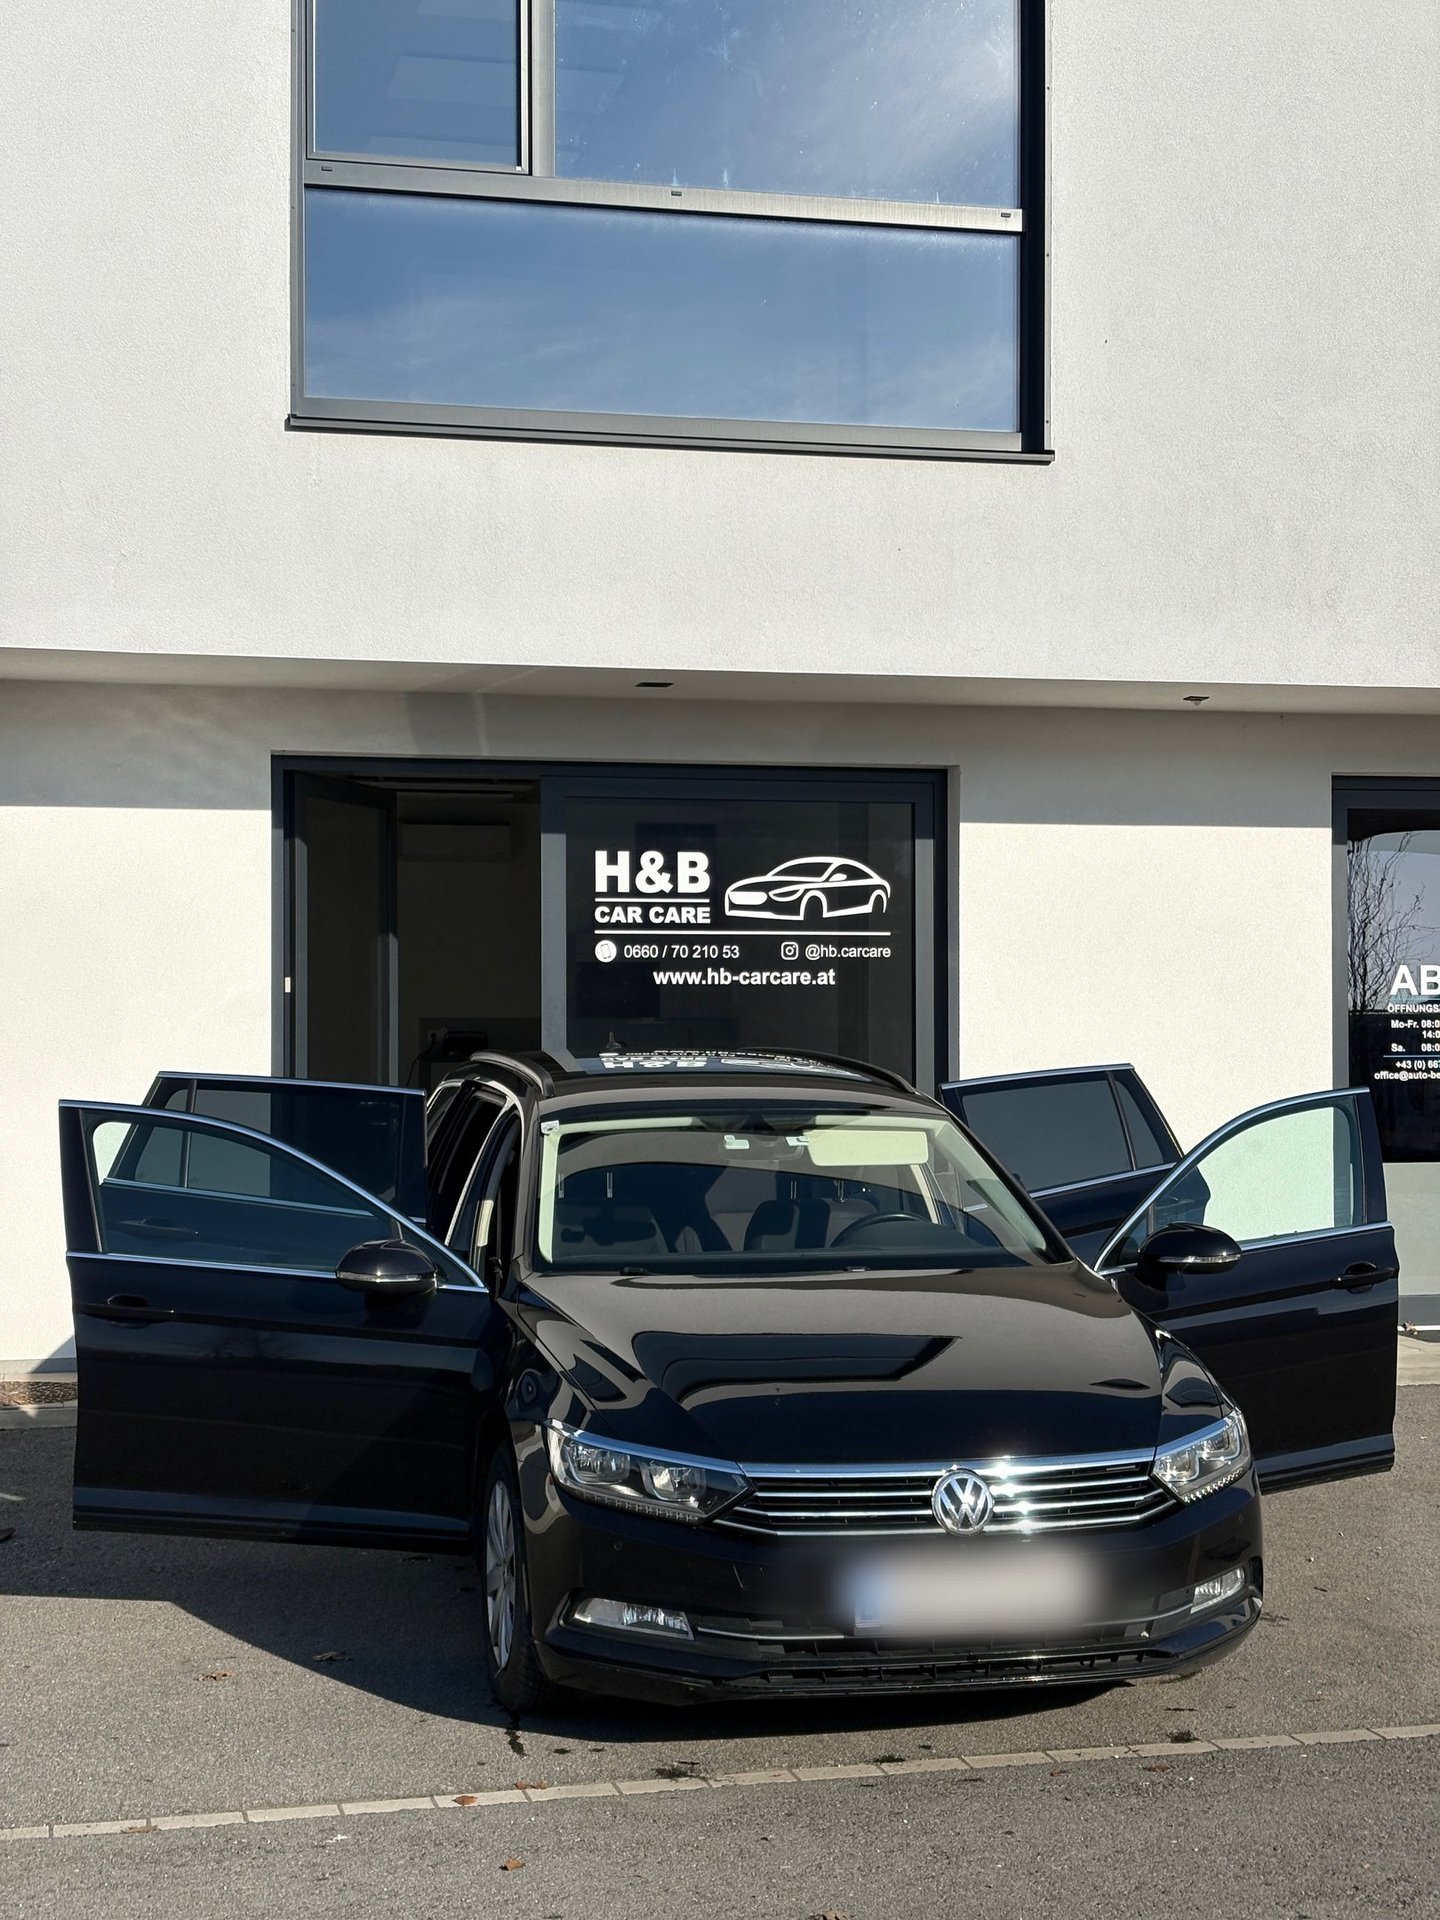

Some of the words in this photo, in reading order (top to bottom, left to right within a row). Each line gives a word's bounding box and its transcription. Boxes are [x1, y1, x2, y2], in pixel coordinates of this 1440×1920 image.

[594, 850, 711, 894] H&B
[594, 906, 643, 924] CAR
[648, 906, 711, 925] CARE
[623, 945, 658, 959] 0660
[661, 945, 667, 959] /
[671, 945, 688, 959] 70
[692, 945, 718, 959] 210
[722, 945, 740, 960] 53
[804, 944, 892, 961] @hb.carcare
[652, 967, 836, 986] www.hb-carcare.at
[1390, 964, 1440, 995] AB
[1391, 1020, 1419, 1029] Mo-Fr.
[1390, 1043, 1406, 1052] Sa.
[1395, 1060, 1412, 1069] +43
[1413, 1060, 1426, 1070] (0)
